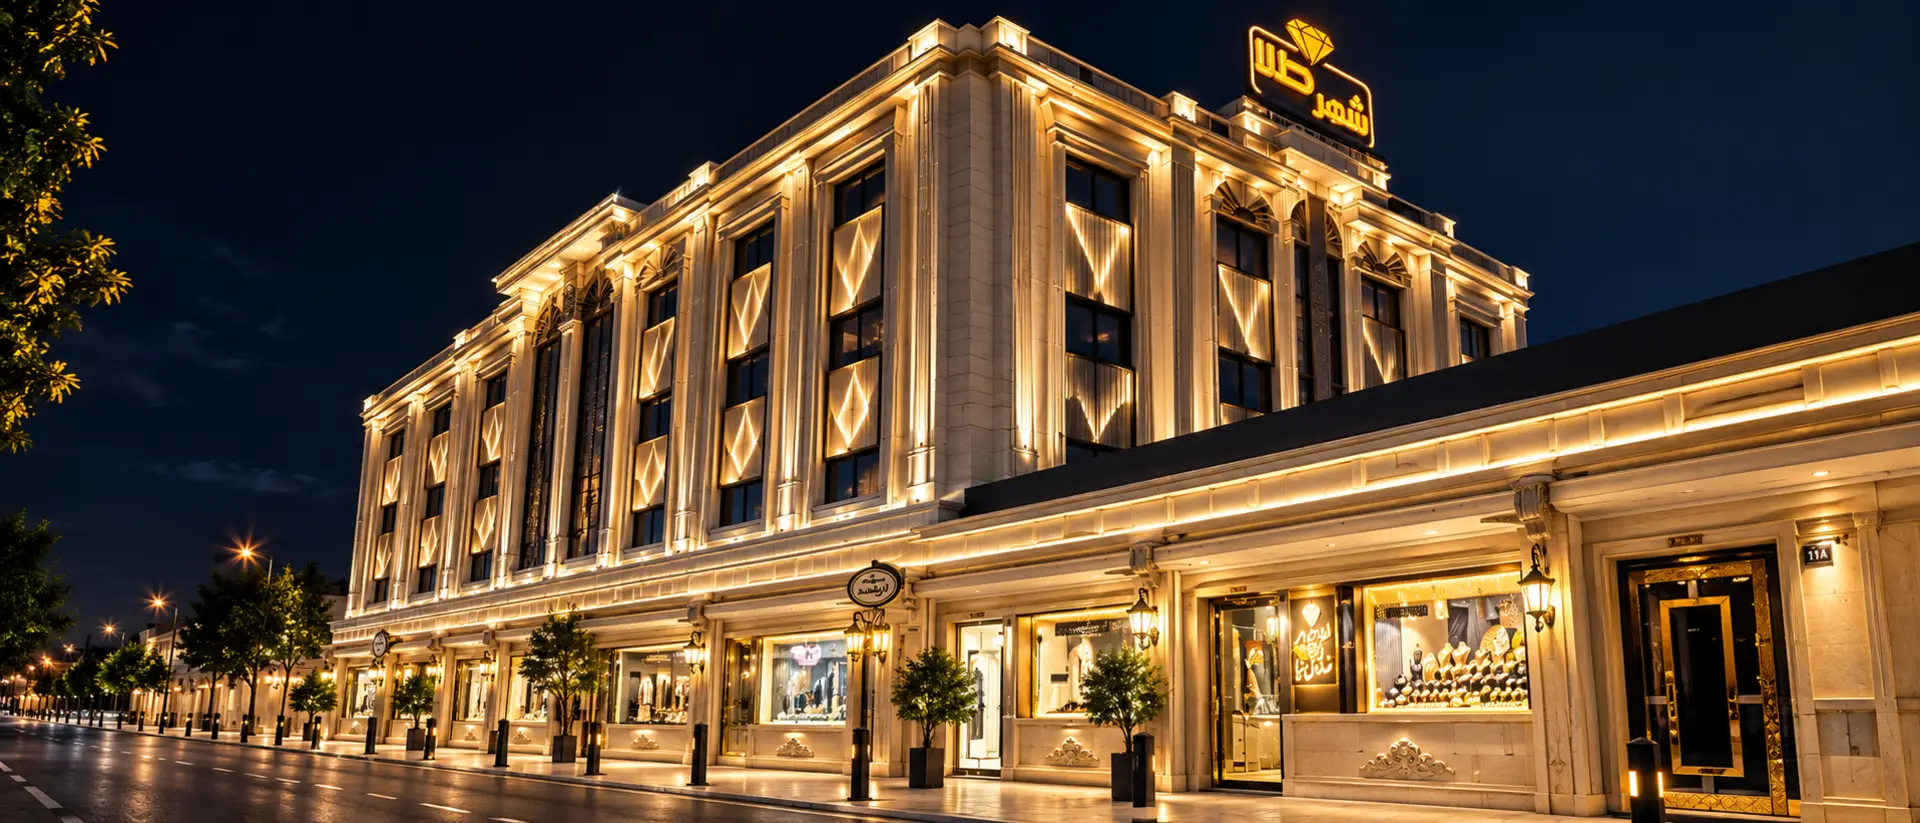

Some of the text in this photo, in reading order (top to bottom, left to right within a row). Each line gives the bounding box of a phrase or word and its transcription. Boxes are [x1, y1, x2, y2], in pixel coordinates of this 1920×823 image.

[1254, 36, 1370, 137] شهر طلا
[1808, 547, 1828, 560] 11A
